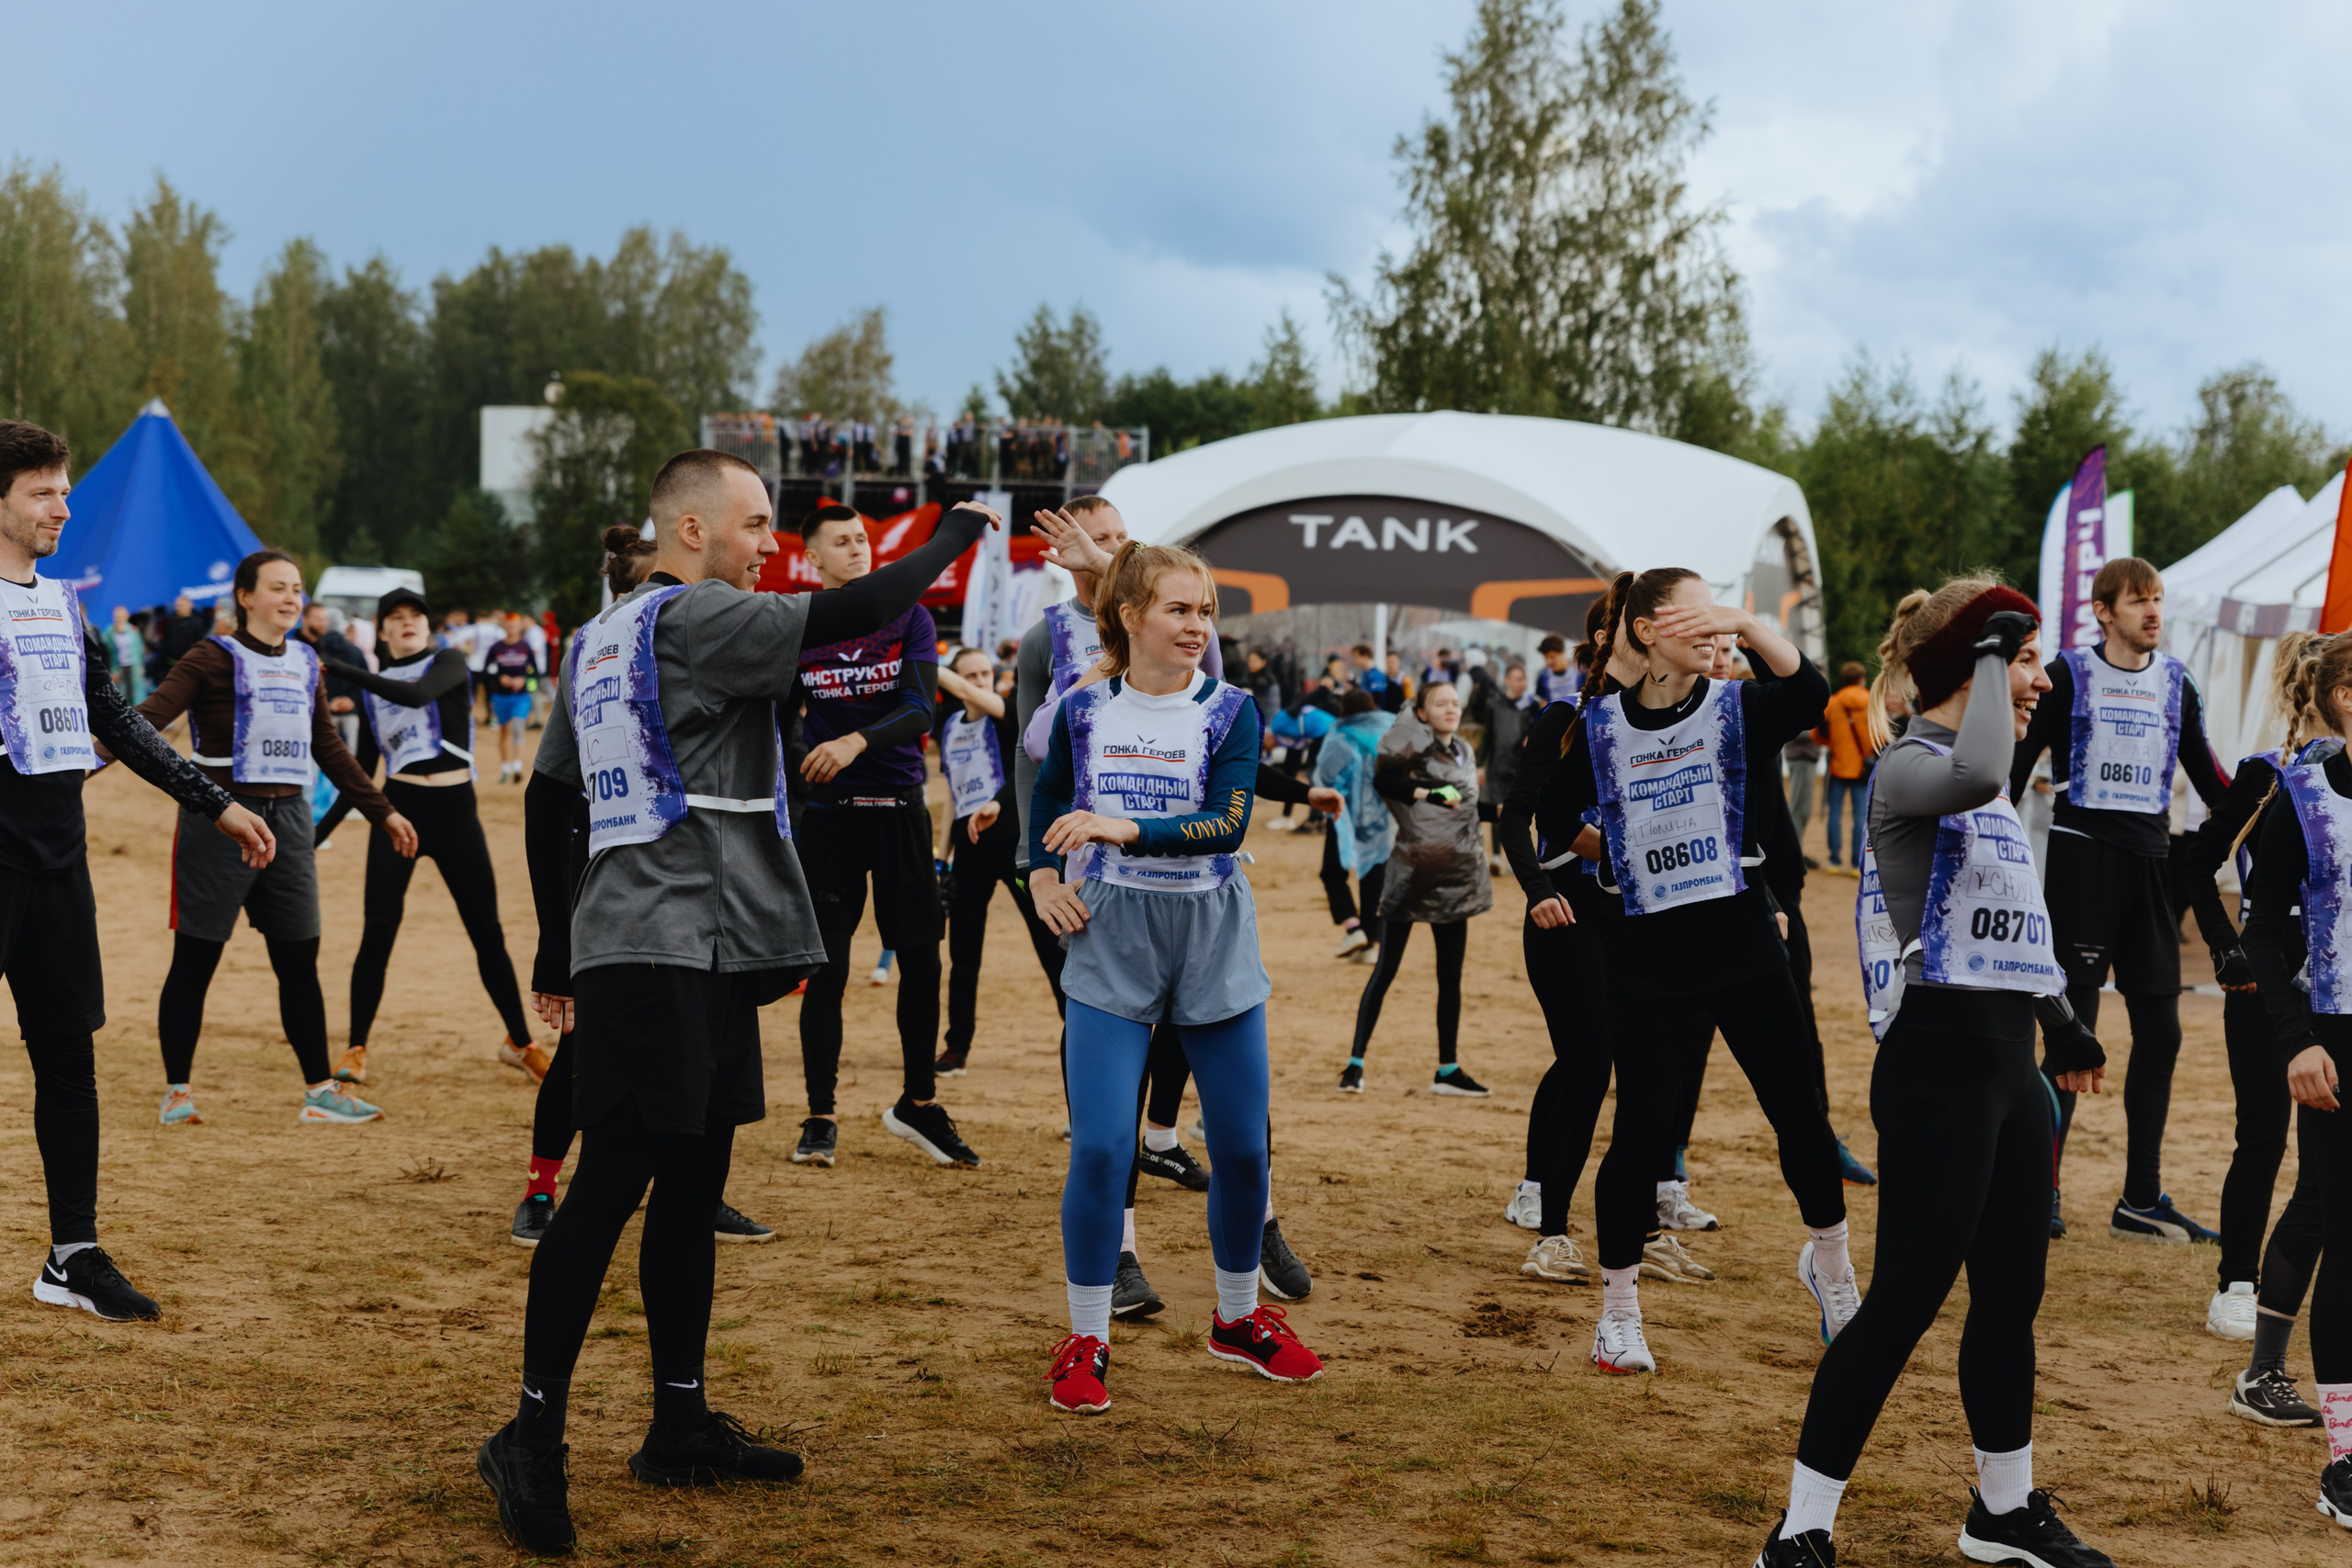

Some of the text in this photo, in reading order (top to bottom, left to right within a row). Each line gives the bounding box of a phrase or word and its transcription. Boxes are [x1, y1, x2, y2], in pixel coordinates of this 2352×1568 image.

[1288, 514, 1479, 553] TANK
[2074, 507, 2103, 646] МЕРЧ
[8, 607, 62, 619] ГОНКА ГЕРОЕВ
[17, 635, 75, 653] КОМАНДНЫЙ
[597, 644, 619, 660] ЕРОЕВ
[41, 653, 68, 669] СТАРТ
[800, 658, 902, 687] ИНСТРУКТО
[812, 686, 853, 699] ГОНКА
[2102, 687, 2156, 699] ГОНКА ГЕРОЕВ
[39, 706, 86, 734] 08601
[2100, 708, 2159, 727] КОМАНДНЫЙ
[2117, 723, 2145, 737] СТАРТ
[60, 745, 91, 756] ГАЗПРОМБАНК
[263, 739, 308, 760] 08801
[1103, 744, 1185, 759] ГОНКА ГЕРОЕВ
[1630, 739, 1704, 765] ГОНКА ГЕРОЕВ
[1630, 763, 1713, 798] КОМАНДНЫЙ
[2100, 762, 2152, 785] 08610
[586, 766, 629, 807] 709
[1099, 775, 1188, 797] КОМАНДНЫЙ
[1125, 794, 1164, 811] СТАРТ
[1654, 787, 1691, 810] СТАРТ
[2112, 793, 2150, 803] ГАЗПРОМБАНК
[1645, 836, 1718, 874] 08608
[1136, 870, 1200, 880] ГАЗПРОМБАНК
[1671, 874, 1723, 893] ГАЗПРОМБАНК
[1971, 908, 2046, 946] 08707
[1993, 959, 2054, 976] ГАЗПРОМБАНК
